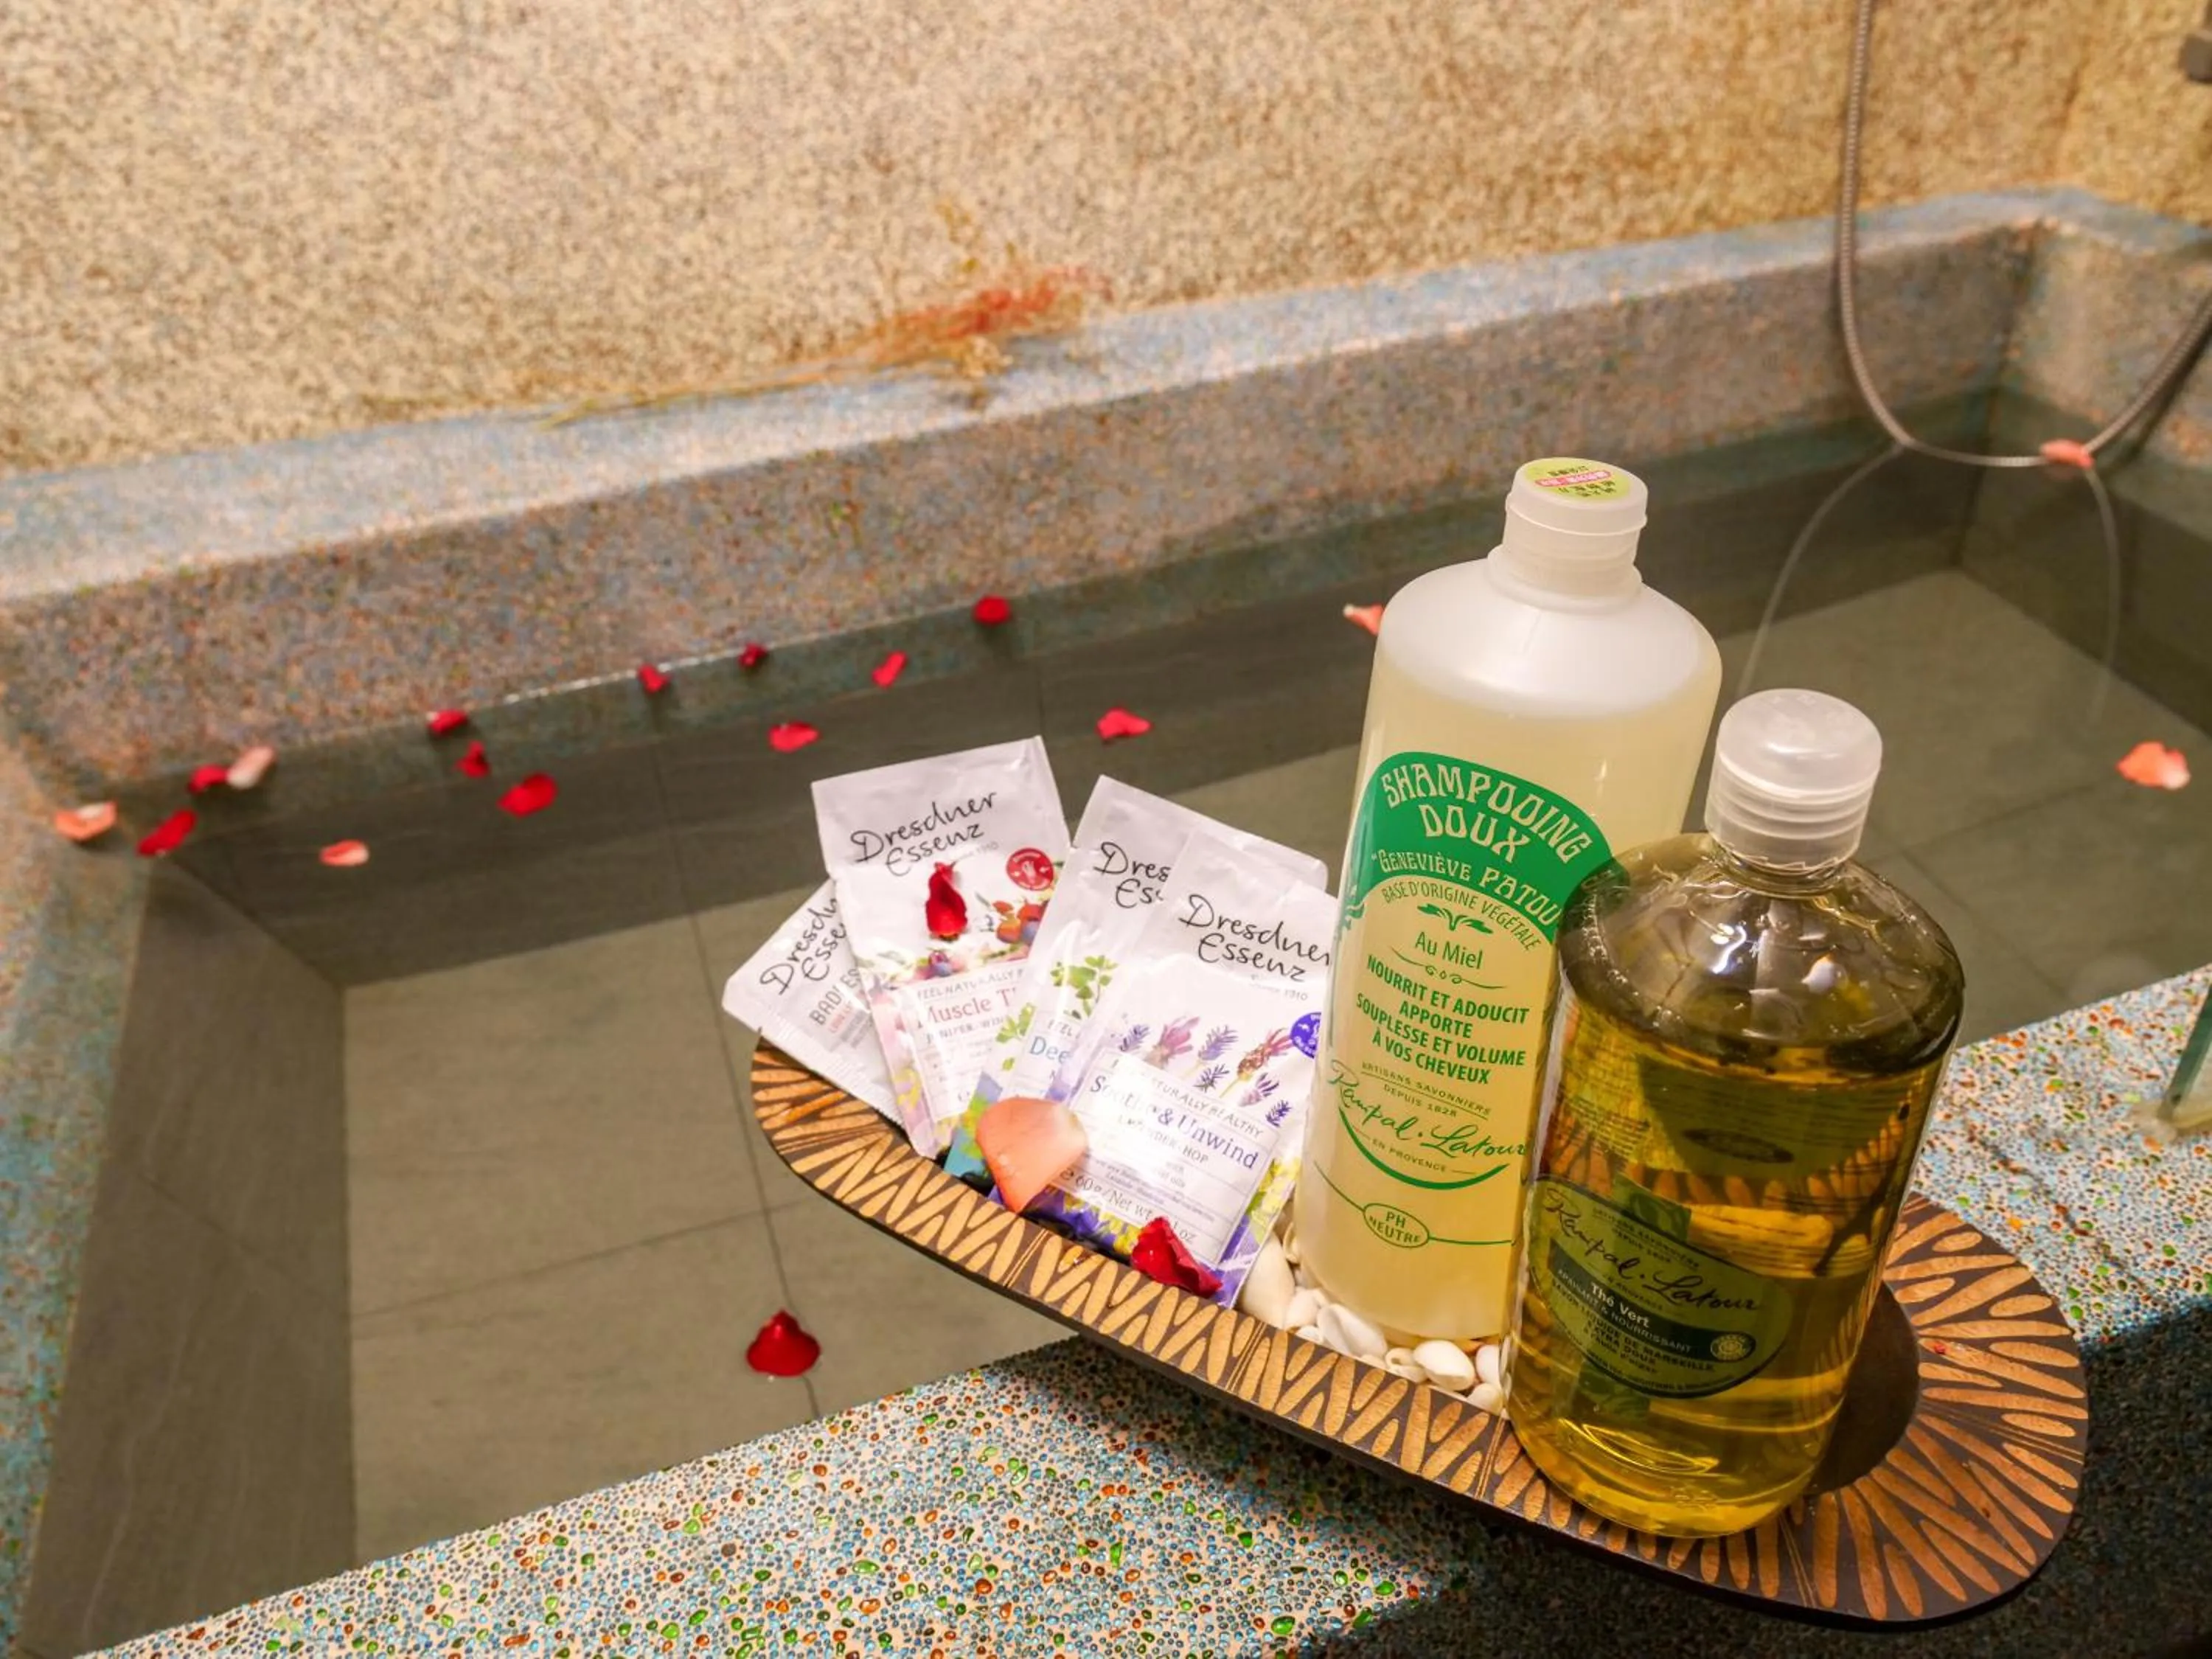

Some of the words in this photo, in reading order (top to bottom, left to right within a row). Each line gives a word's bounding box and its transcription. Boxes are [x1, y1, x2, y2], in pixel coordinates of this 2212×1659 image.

[850, 791, 997, 863] Dresdner
[1380, 763, 1593, 864] SHAMPOOING
[1419, 804, 1530, 863] DOUX
[886, 823, 984, 877] Essenz
[1381, 882, 1409, 903] BASE
[1409, 881, 1478, 909] D'ORIGINE
[1481, 900, 1543, 951] VÉGÉTALE
[1198, 933, 1306, 982] Essenz
[1415, 931, 1438, 956] Au
[1442, 941, 1483, 970] Miel
[1367, 955, 1427, 1001] NOURRIT
[1430, 990, 1450, 1009] ET
[1453, 998, 1529, 1024] ADOUCIT
[1357, 992, 1429, 1048] SOUPLESSE
[1432, 1036, 1453, 1055] ET
[1456, 1043, 1526, 1066] VOLUME
[1399, 1000, 1473, 1039] APPORTE
[1385, 1037, 1412, 1062] VOS
[1415, 1052, 1491, 1085] CHEVEUX
[1141, 1072, 1208, 1113] TURALLY
[1328, 1060, 1419, 1141] Rampal
[1420, 1124, 1527, 1158] Latour
[1362, 1062, 1411, 1085] ARTISANS
[1416, 1081, 1492, 1116] SAVONNIERS
[1384, 1084, 1422, 1107] DEPUIS
[1158, 1107, 1174, 1126] &
[1178, 1113, 1259, 1169] Unwind
[1182, 1145, 1209, 1164] HOP
[1372, 1138, 1385, 1150] EN
[1389, 1147, 1447, 1172] PROVENCE
[1369, 1215, 1420, 1243] NEUTRE
[1385, 1211, 1405, 1228] PH
[1545, 1187, 1641, 1280] Rampal
[1642, 1270, 1759, 1312] Latour
[1590, 1282, 1615, 1307] Thé
[1619, 1302, 1650, 1328] Vert
